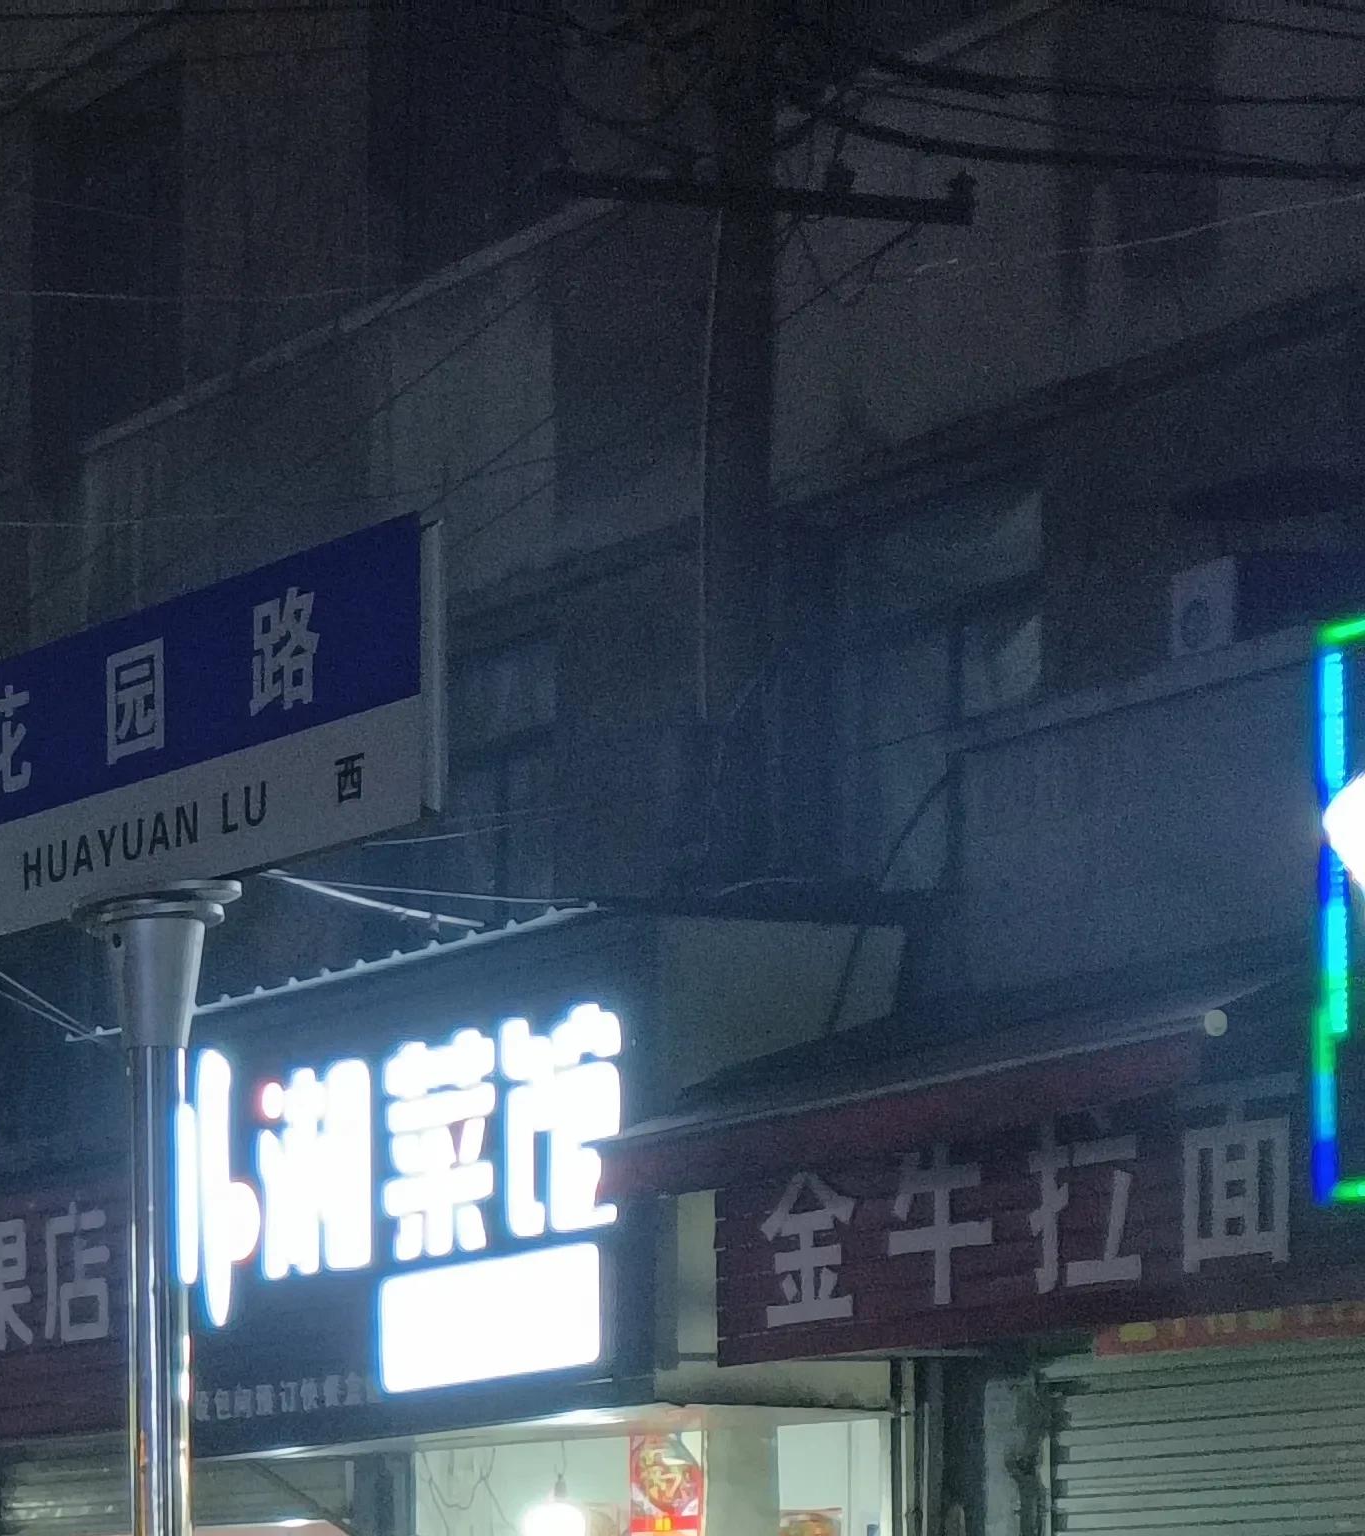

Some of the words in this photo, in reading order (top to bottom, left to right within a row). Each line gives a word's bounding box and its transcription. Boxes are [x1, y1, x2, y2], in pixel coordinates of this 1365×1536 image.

[21, 800, 201, 892] HUAYUAN
[220, 780, 269, 835] LU
[334, 752, 366, 806] 西
